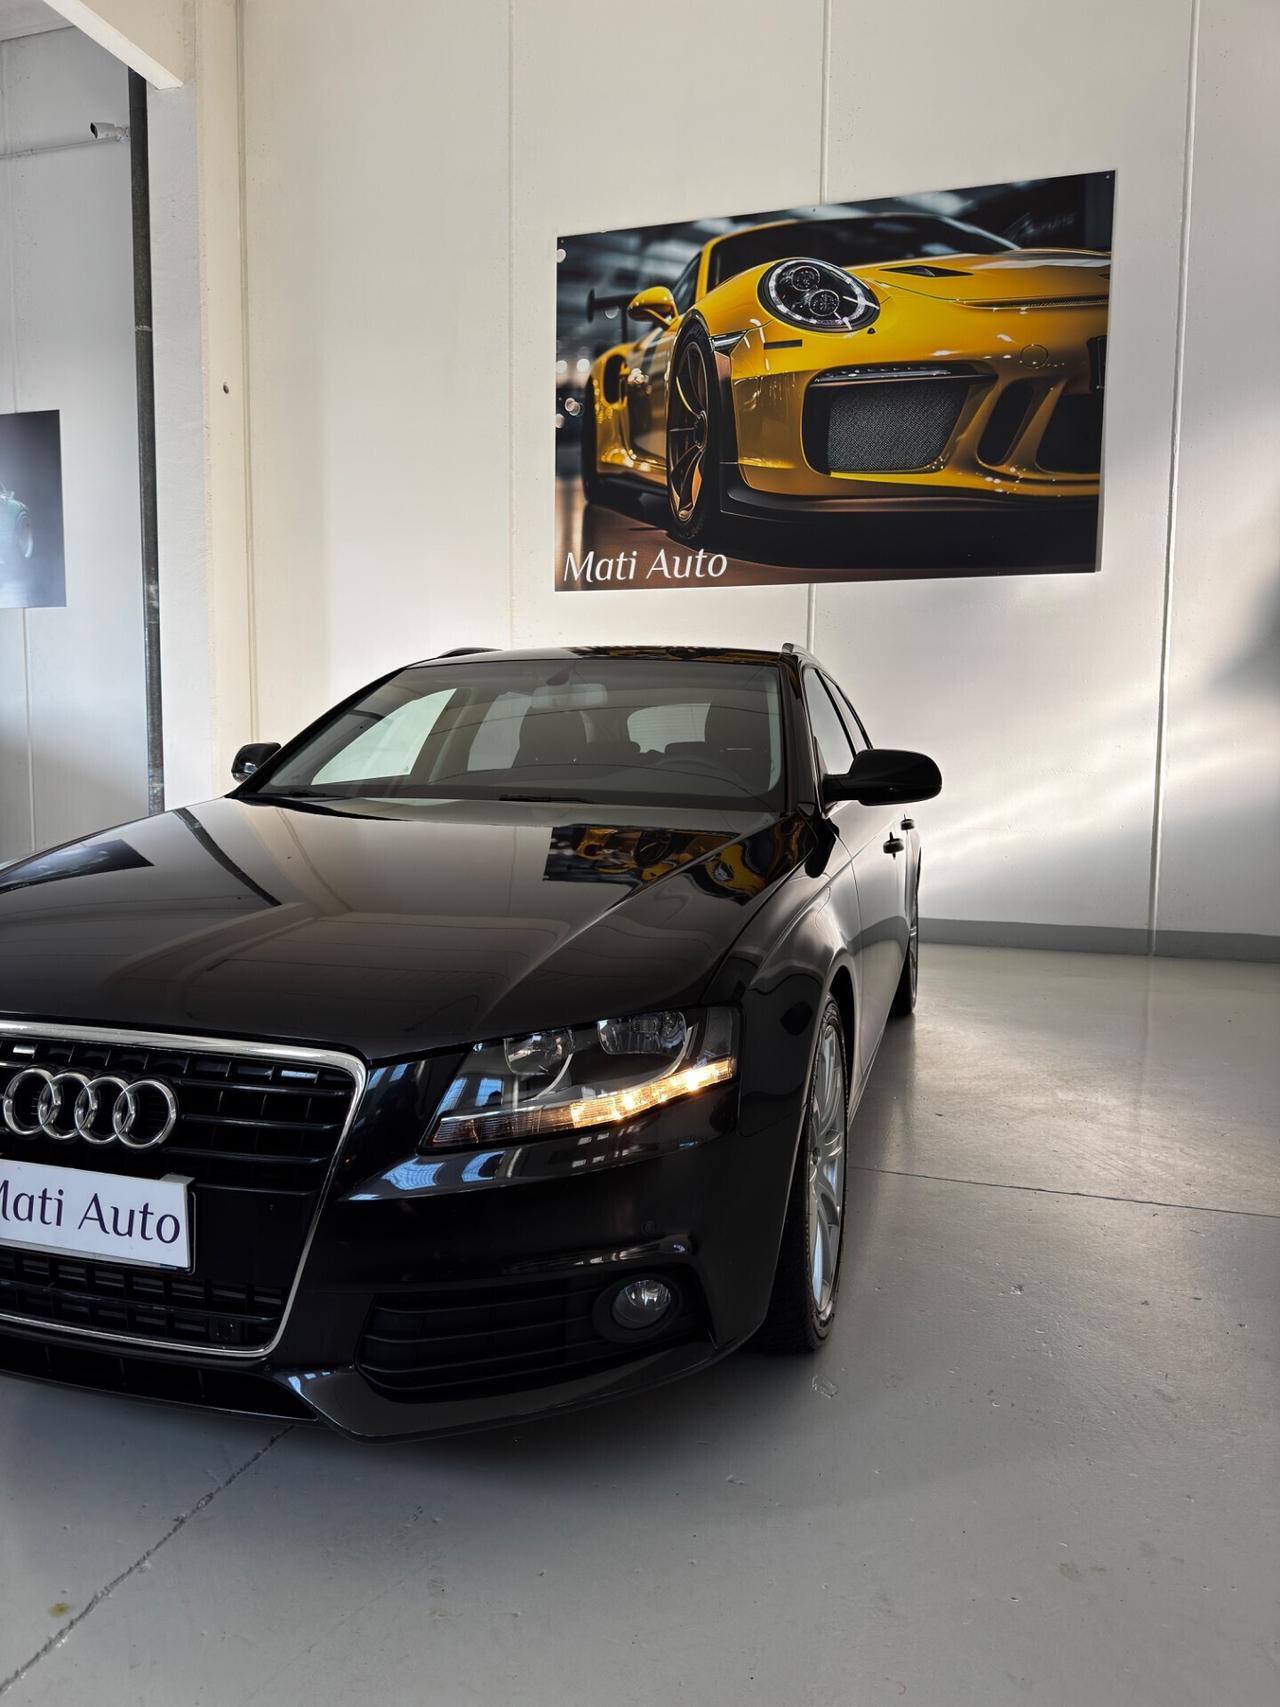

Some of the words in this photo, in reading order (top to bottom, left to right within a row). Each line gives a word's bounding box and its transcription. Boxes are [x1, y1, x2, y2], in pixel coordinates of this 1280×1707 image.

[563, 550, 637, 583] Mati
[645, 548, 728, 580] Auto
[77, 1193, 181, 1244] Auto
